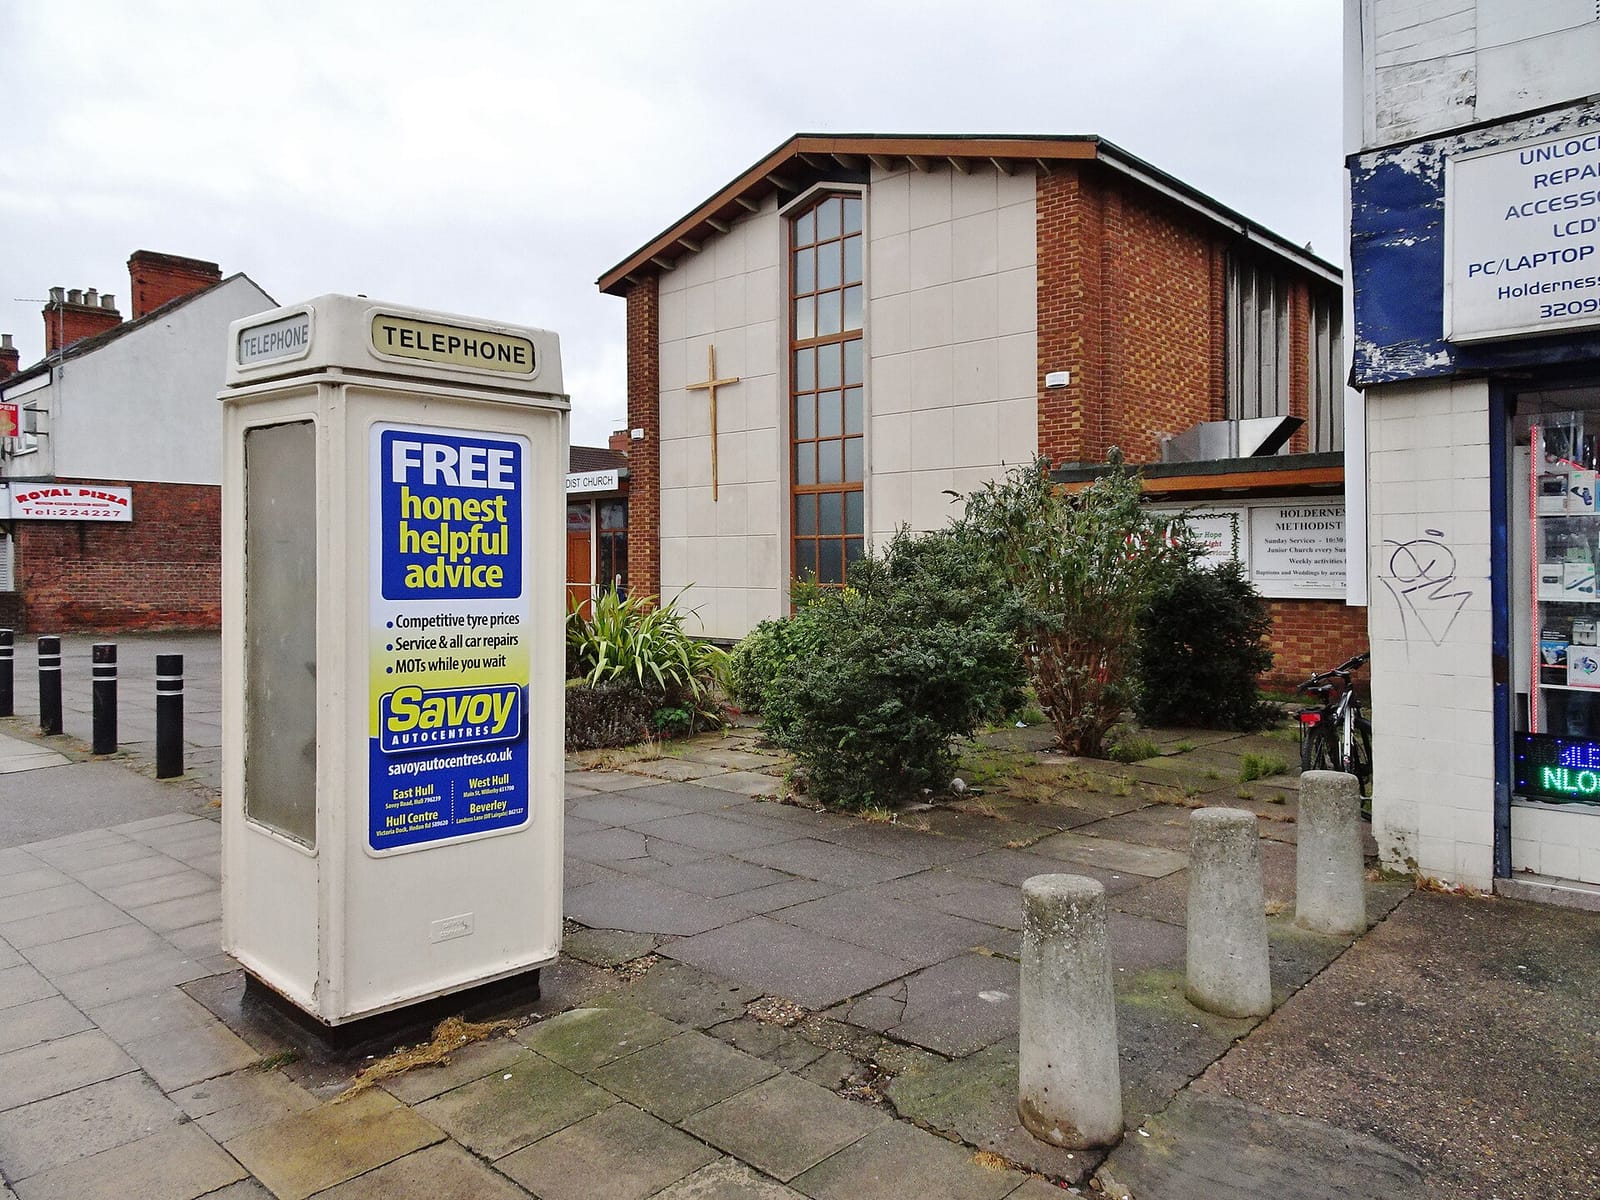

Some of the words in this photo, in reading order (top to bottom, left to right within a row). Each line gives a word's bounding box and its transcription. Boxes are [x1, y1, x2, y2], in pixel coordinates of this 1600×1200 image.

[1504, 190, 1600, 220] ACCESS
[1468, 246, 1594, 278] PC/LAPTOP
[244, 324, 308, 357] TELEPHONE
[382, 325, 526, 364] TELEPHONE
[392, 440, 514, 490] FREE
[583, 476, 613, 487] CHURCH
[16, 488, 72, 503] ROYAL
[79, 490, 127, 506] PIZZA
[402, 486, 507, 522] honest
[23, 508, 120, 517] Tel:224227
[1276, 522, 1343, 530] METHODIST
[400, 520, 508, 562] helpful
[404, 556, 504, 588] advice
[396, 614, 464, 630] Competitive
[467, 614, 488, 629] tyre
[490, 612, 520, 628] prices
[395, 636, 436, 651] Service
[439, 635, 448, 648] &
[450, 634, 463, 648] all
[465, 637, 481, 647] car
[483, 633, 518, 649] repairs
[396, 659, 426, 673] MOTs
[428, 656, 458, 671] while
[461, 659, 480, 672] you
[483, 654, 506, 668] wait
[387, 686, 516, 734] Savoy
[392, 726, 488, 745] AUTOCENTRES
[388, 748, 512, 776] savoyautocentres.co.uk
[469, 778, 490, 789] West
[492, 773, 509, 786] Hull
[1544, 767, 1600, 792] NLO
[393, 788, 413, 800] East
[415, 784, 434, 797] Hull
[470, 800, 507, 814] Beverley
[386, 814, 405, 827] Hull
[408, 811, 438, 823] Centre
